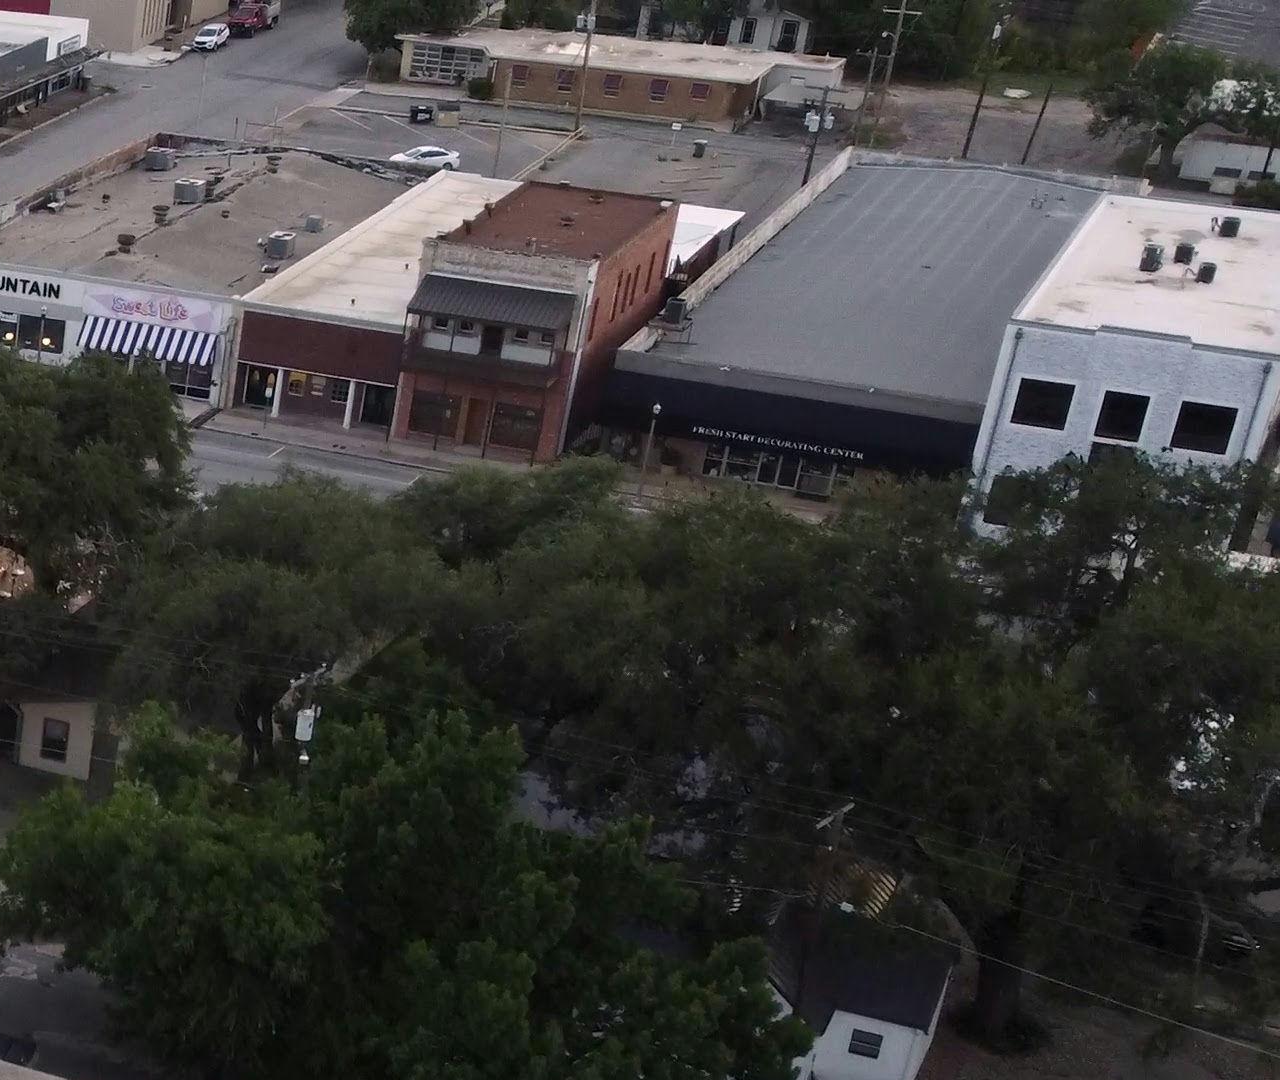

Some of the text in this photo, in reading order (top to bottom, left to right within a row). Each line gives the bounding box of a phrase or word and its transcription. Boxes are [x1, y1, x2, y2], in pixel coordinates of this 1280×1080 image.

[692, 425, 864, 460] FRESH START DECORATING CENTER
